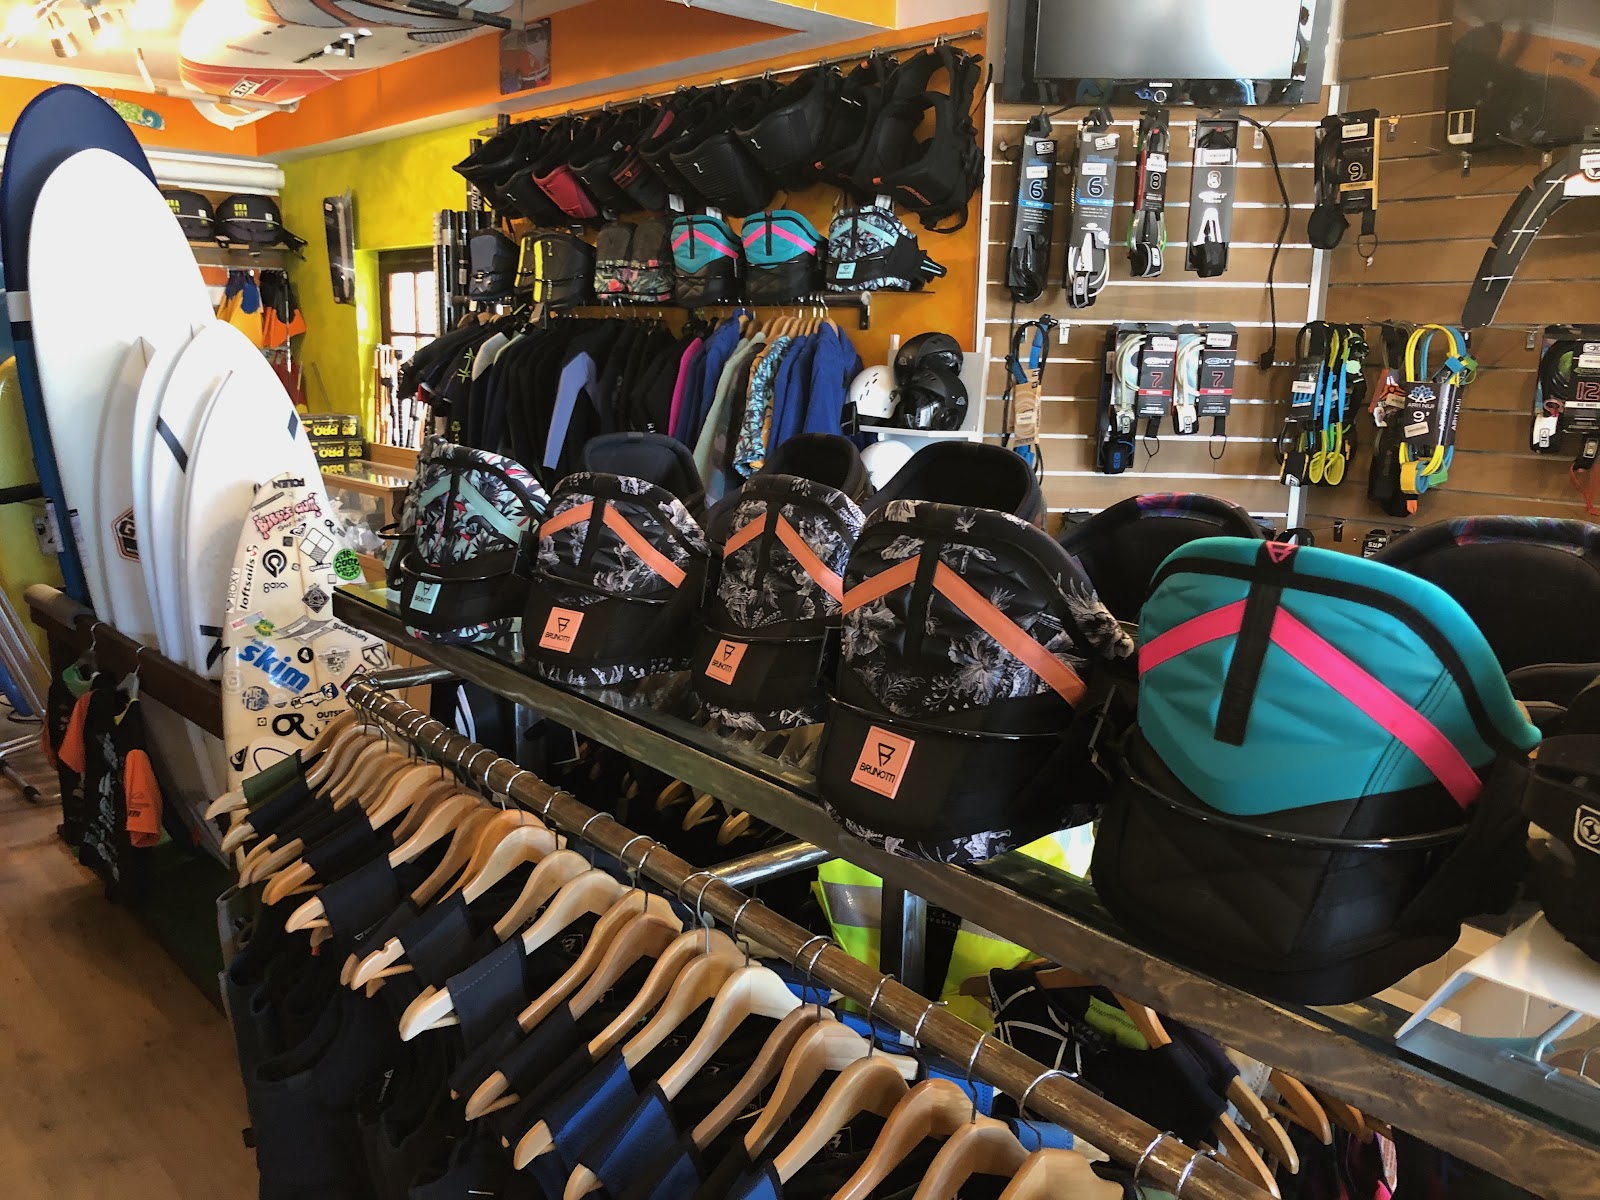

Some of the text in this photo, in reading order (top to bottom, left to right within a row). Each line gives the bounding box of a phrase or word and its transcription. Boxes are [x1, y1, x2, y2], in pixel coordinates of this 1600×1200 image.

[1149, 172, 1162, 189] 8
[1347, 162, 1364, 181] 9
[1028, 179, 1044, 200] 6
[1087, 176, 1104, 198] 6
[1151, 372, 1163, 387] 7
[1212, 371, 1225, 387] 7
[1576, 381, 1600, 400] 12
[252, 493, 323, 540] BUBBLE GUM
[228, 569, 240, 599] ROXY
[239, 558, 256, 610] loftsails
[332, 622, 369, 642] Surfactory
[544, 631, 571, 643] BRUNOTTI
[238, 645, 311, 692] skim
[711, 658, 733, 673] BRUNOTTI
[859, 762, 897, 784] BRUNOTTI
